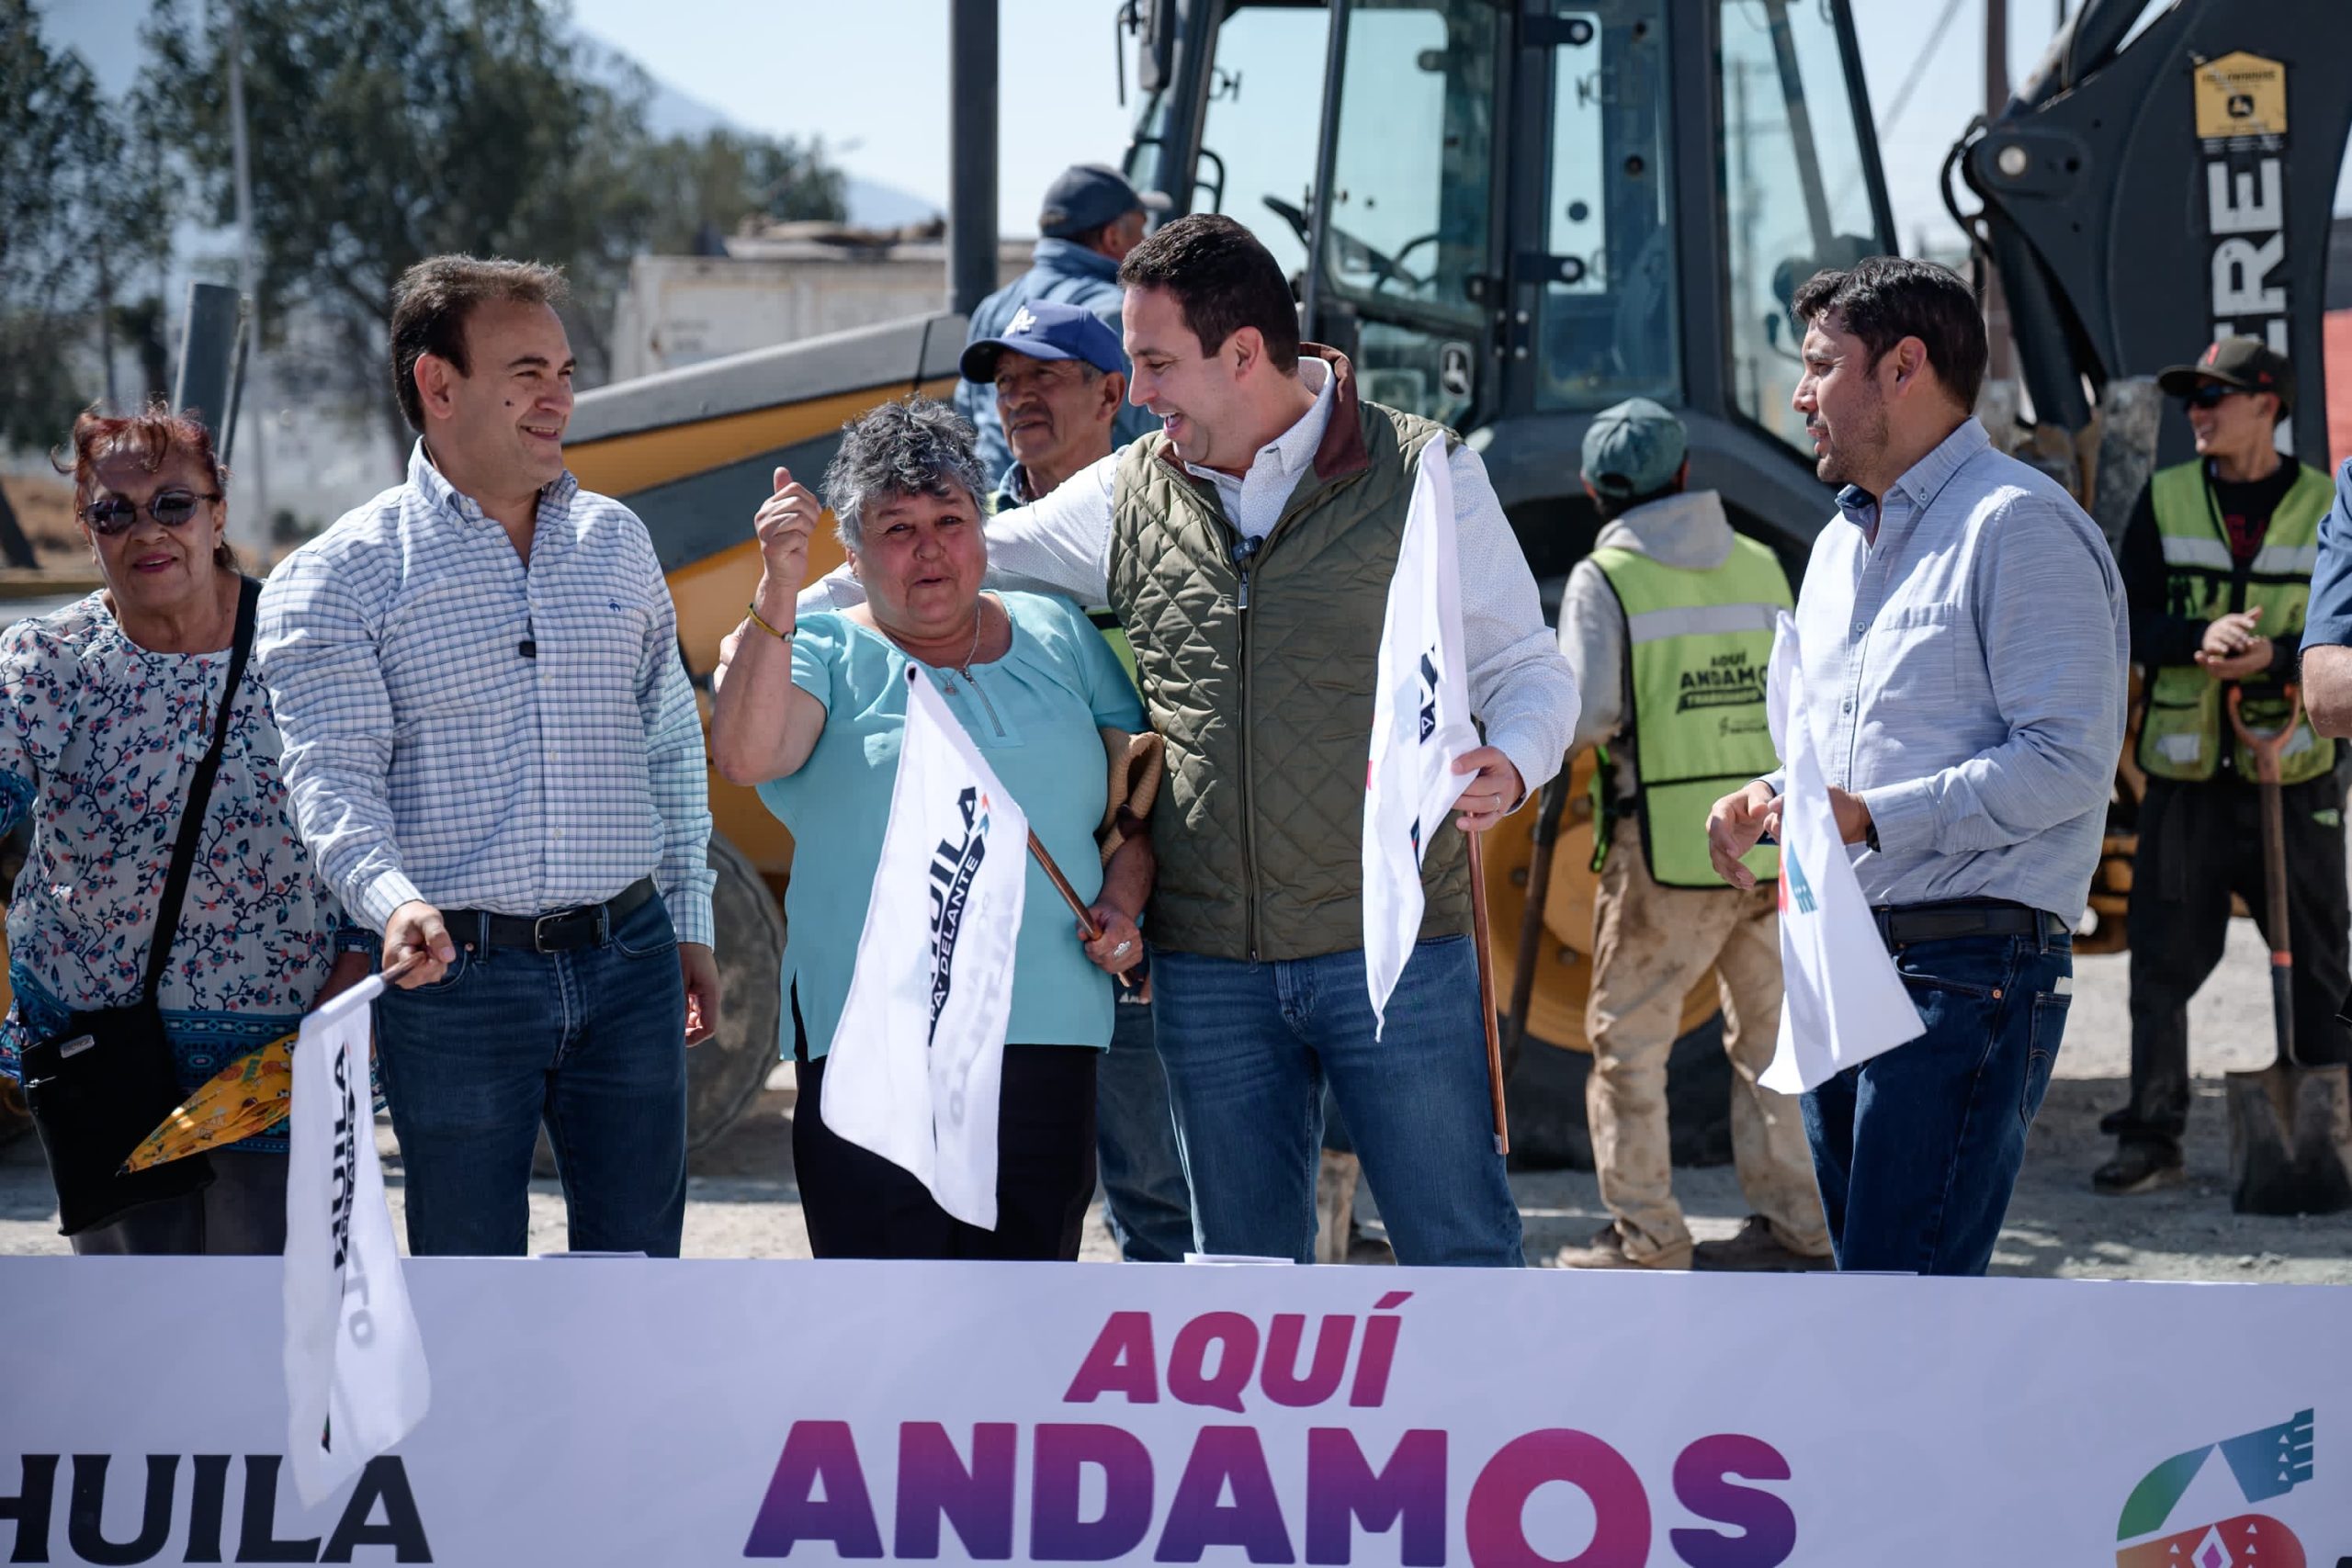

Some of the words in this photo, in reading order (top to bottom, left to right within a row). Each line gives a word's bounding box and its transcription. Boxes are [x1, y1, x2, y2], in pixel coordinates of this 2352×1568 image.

[938, 854, 979, 973] DELANTE
[1063, 1292, 1413, 1413] AQUÍ
[743, 1421, 1796, 1568] ANDAMOS
